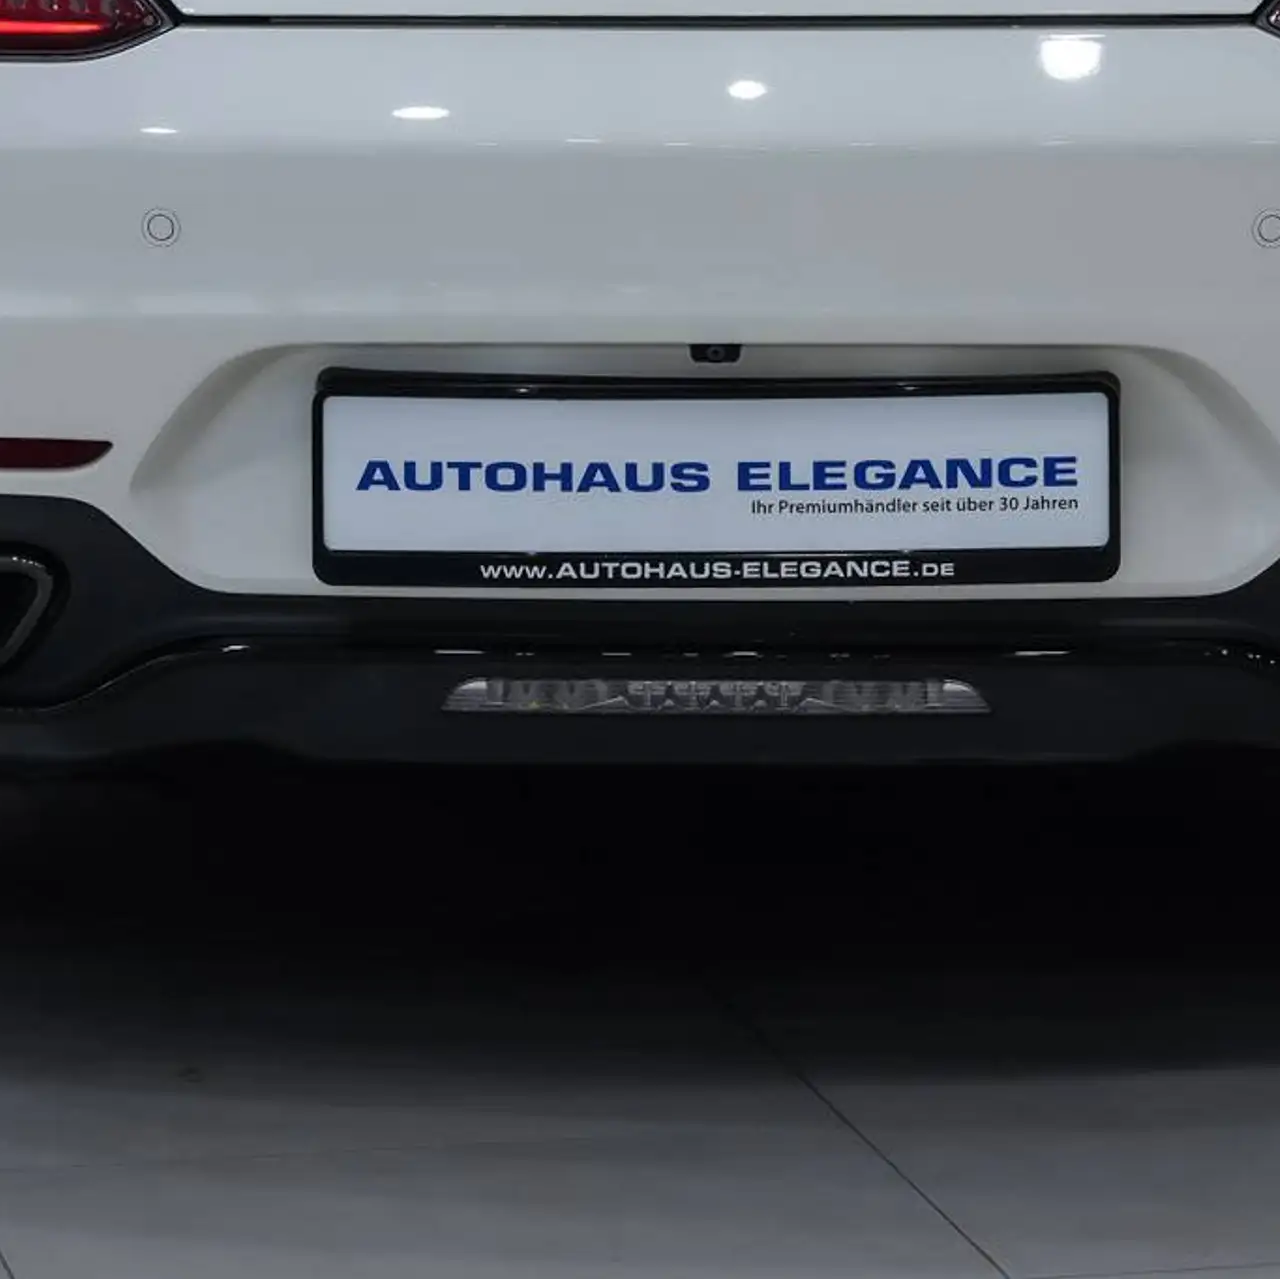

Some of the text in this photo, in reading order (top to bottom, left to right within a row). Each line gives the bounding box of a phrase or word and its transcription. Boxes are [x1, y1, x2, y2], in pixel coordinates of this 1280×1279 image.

[356, 455, 1078, 494] AUTOHAUS ELEGANCE
[750, 495, 1080, 515] Ihr Premiumhändler seit über 30 Jahren
[479, 558, 956, 581] www.AUTOHAUS-ELEGANCE.DE
